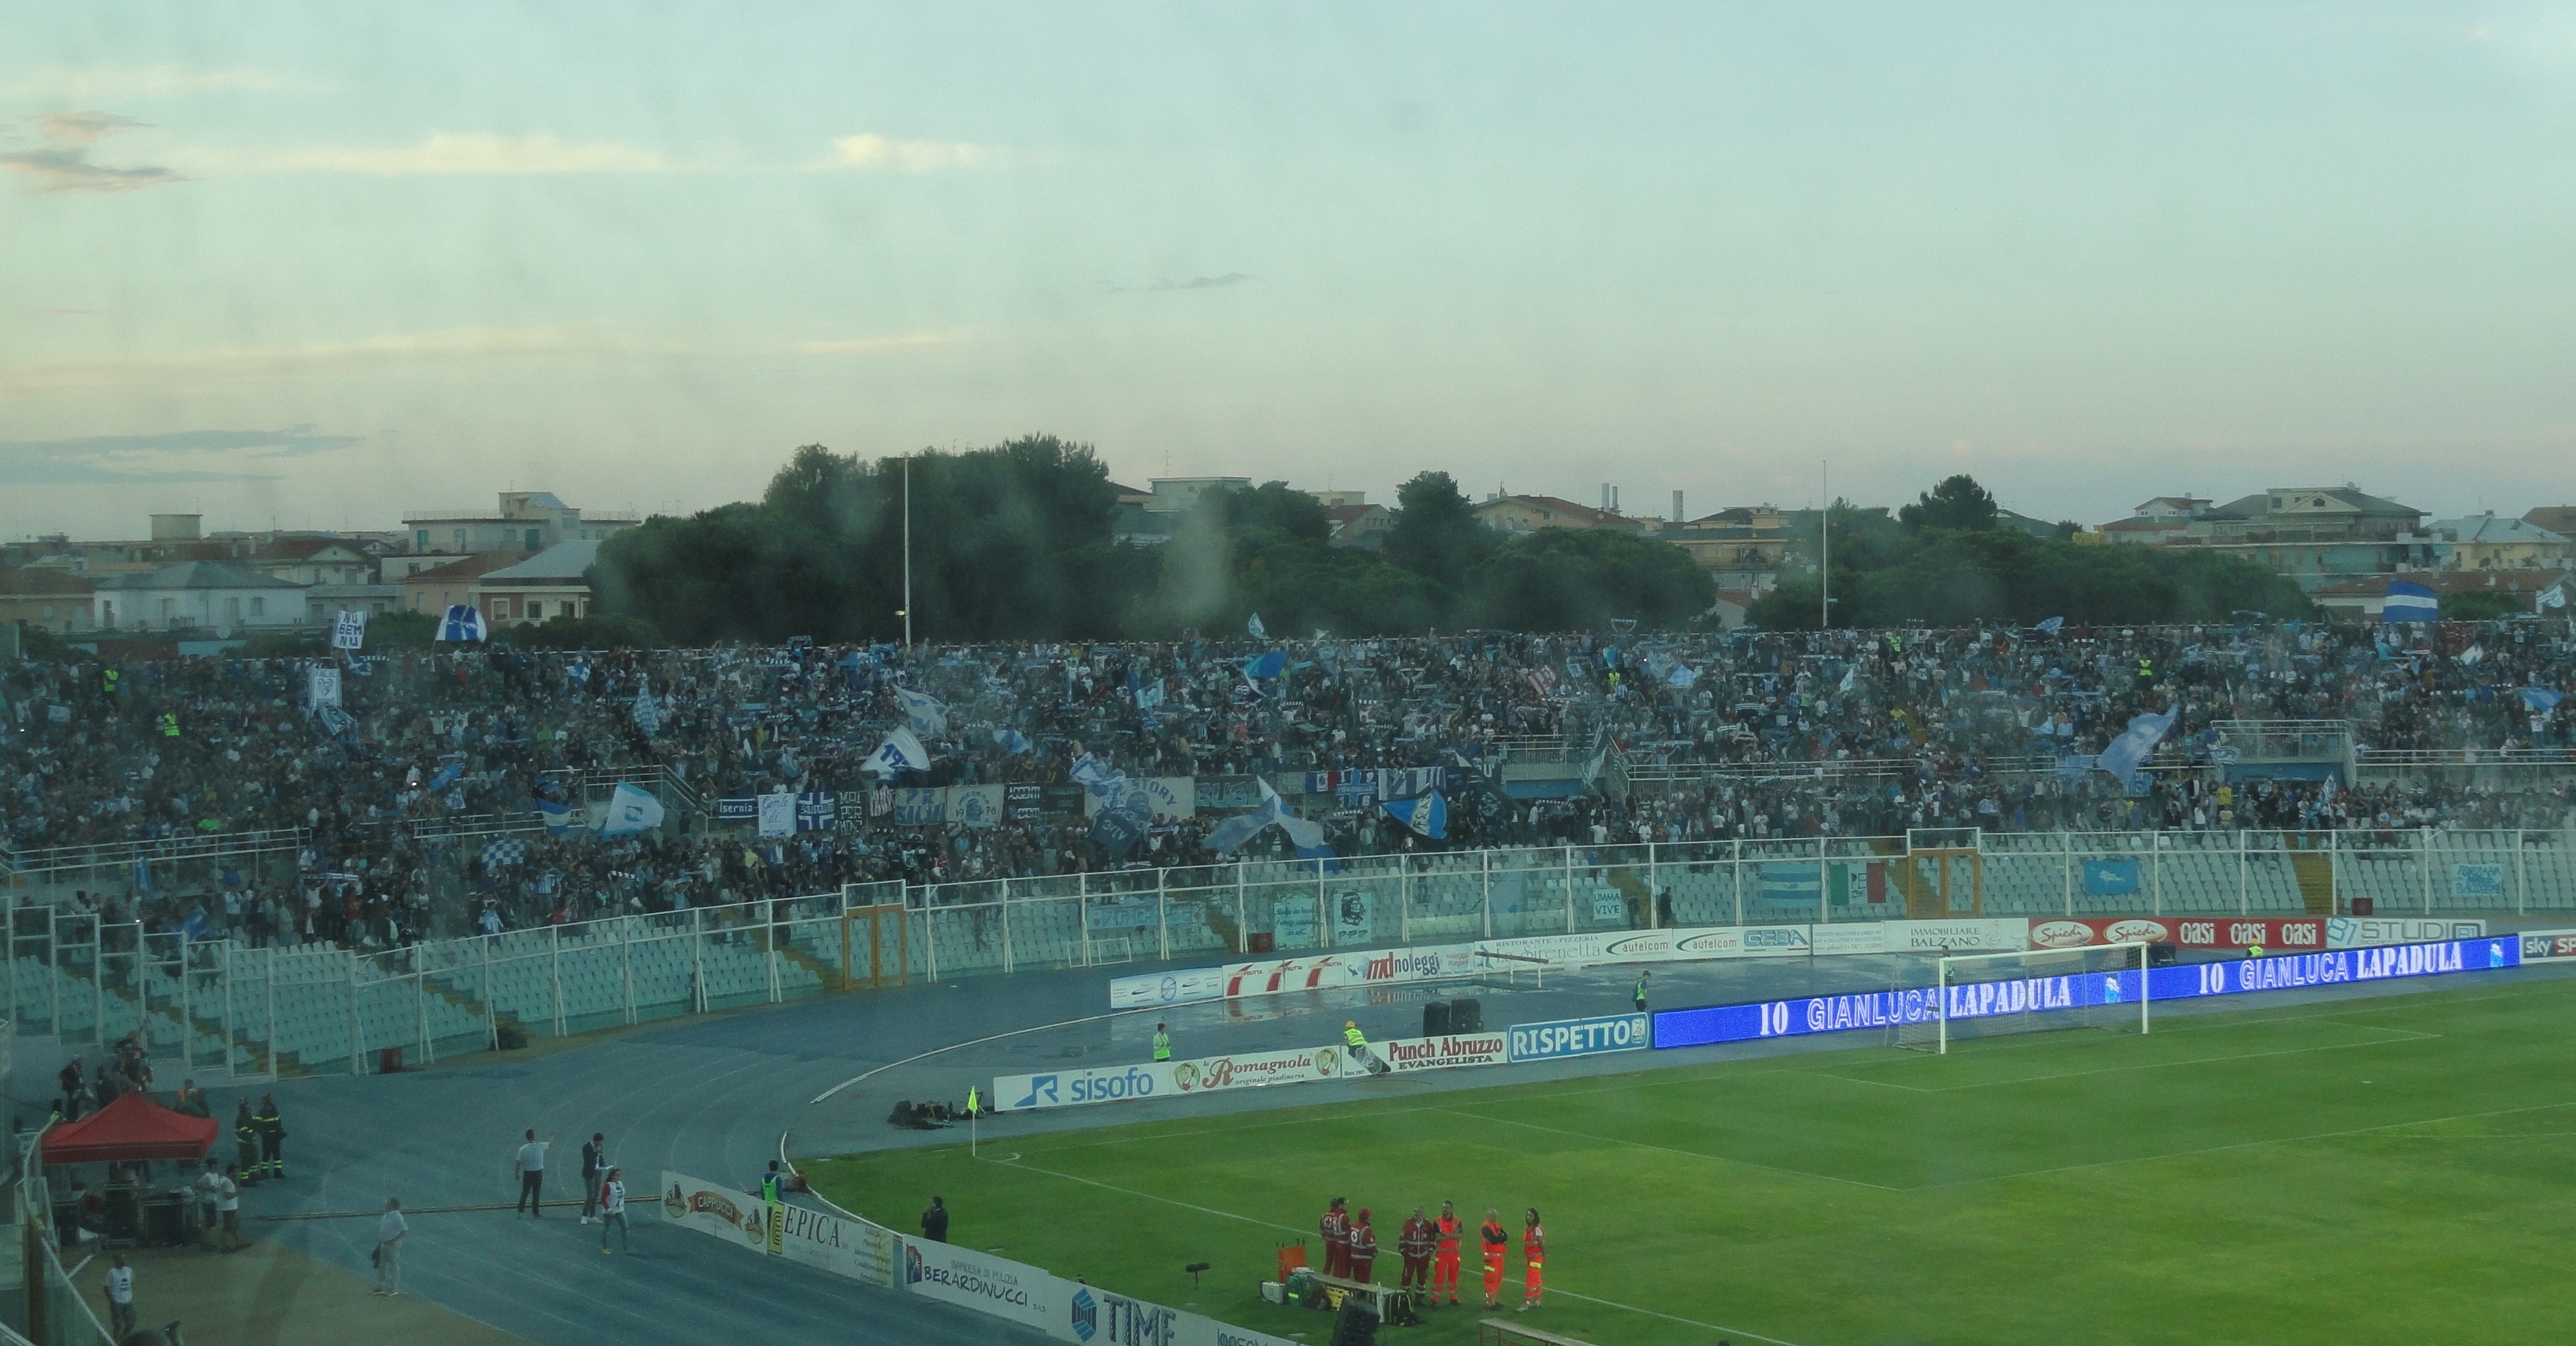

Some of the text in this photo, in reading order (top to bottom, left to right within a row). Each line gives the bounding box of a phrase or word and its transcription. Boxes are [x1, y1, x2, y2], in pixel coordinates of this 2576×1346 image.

[340, 636, 358, 646] NU
[719, 802, 753, 813] Isernia
[1595, 904, 1620, 916] VIVE
[1744, 929, 1809, 946] GEBA
[1911, 927, 1980, 936] IMMOBILIARE
[1496, 938, 1550, 947] RISTORANTE
[1622, 940, 1669, 952] autelcom
[1692, 937, 1738, 949] autelcom
[1911, 937, 1980, 947] BALZANO
[2525, 938, 2552, 955] sky
[2199, 942, 2463, 994] 10 GIANLUCA LAPADULA
[1760, 977, 2072, 1036] 10 GIANLUCA LAPADULA
[1513, 1020, 1630, 1057] RISPETTO
[1389, 1036, 1503, 1062] Punch Abruzzo
[1398, 1054, 1494, 1069] EVANGELISTA
[1202, 1054, 1311, 1089] Romagnola
[1071, 1067, 1154, 1102] sisofo
[698, 1196, 734, 1218] CAPPUCCI
[784, 1206, 841, 1248] EPICA
[950, 1259, 982, 1276] IMPRESA
[924, 1265, 1028, 1307] BERARDINUCCI
